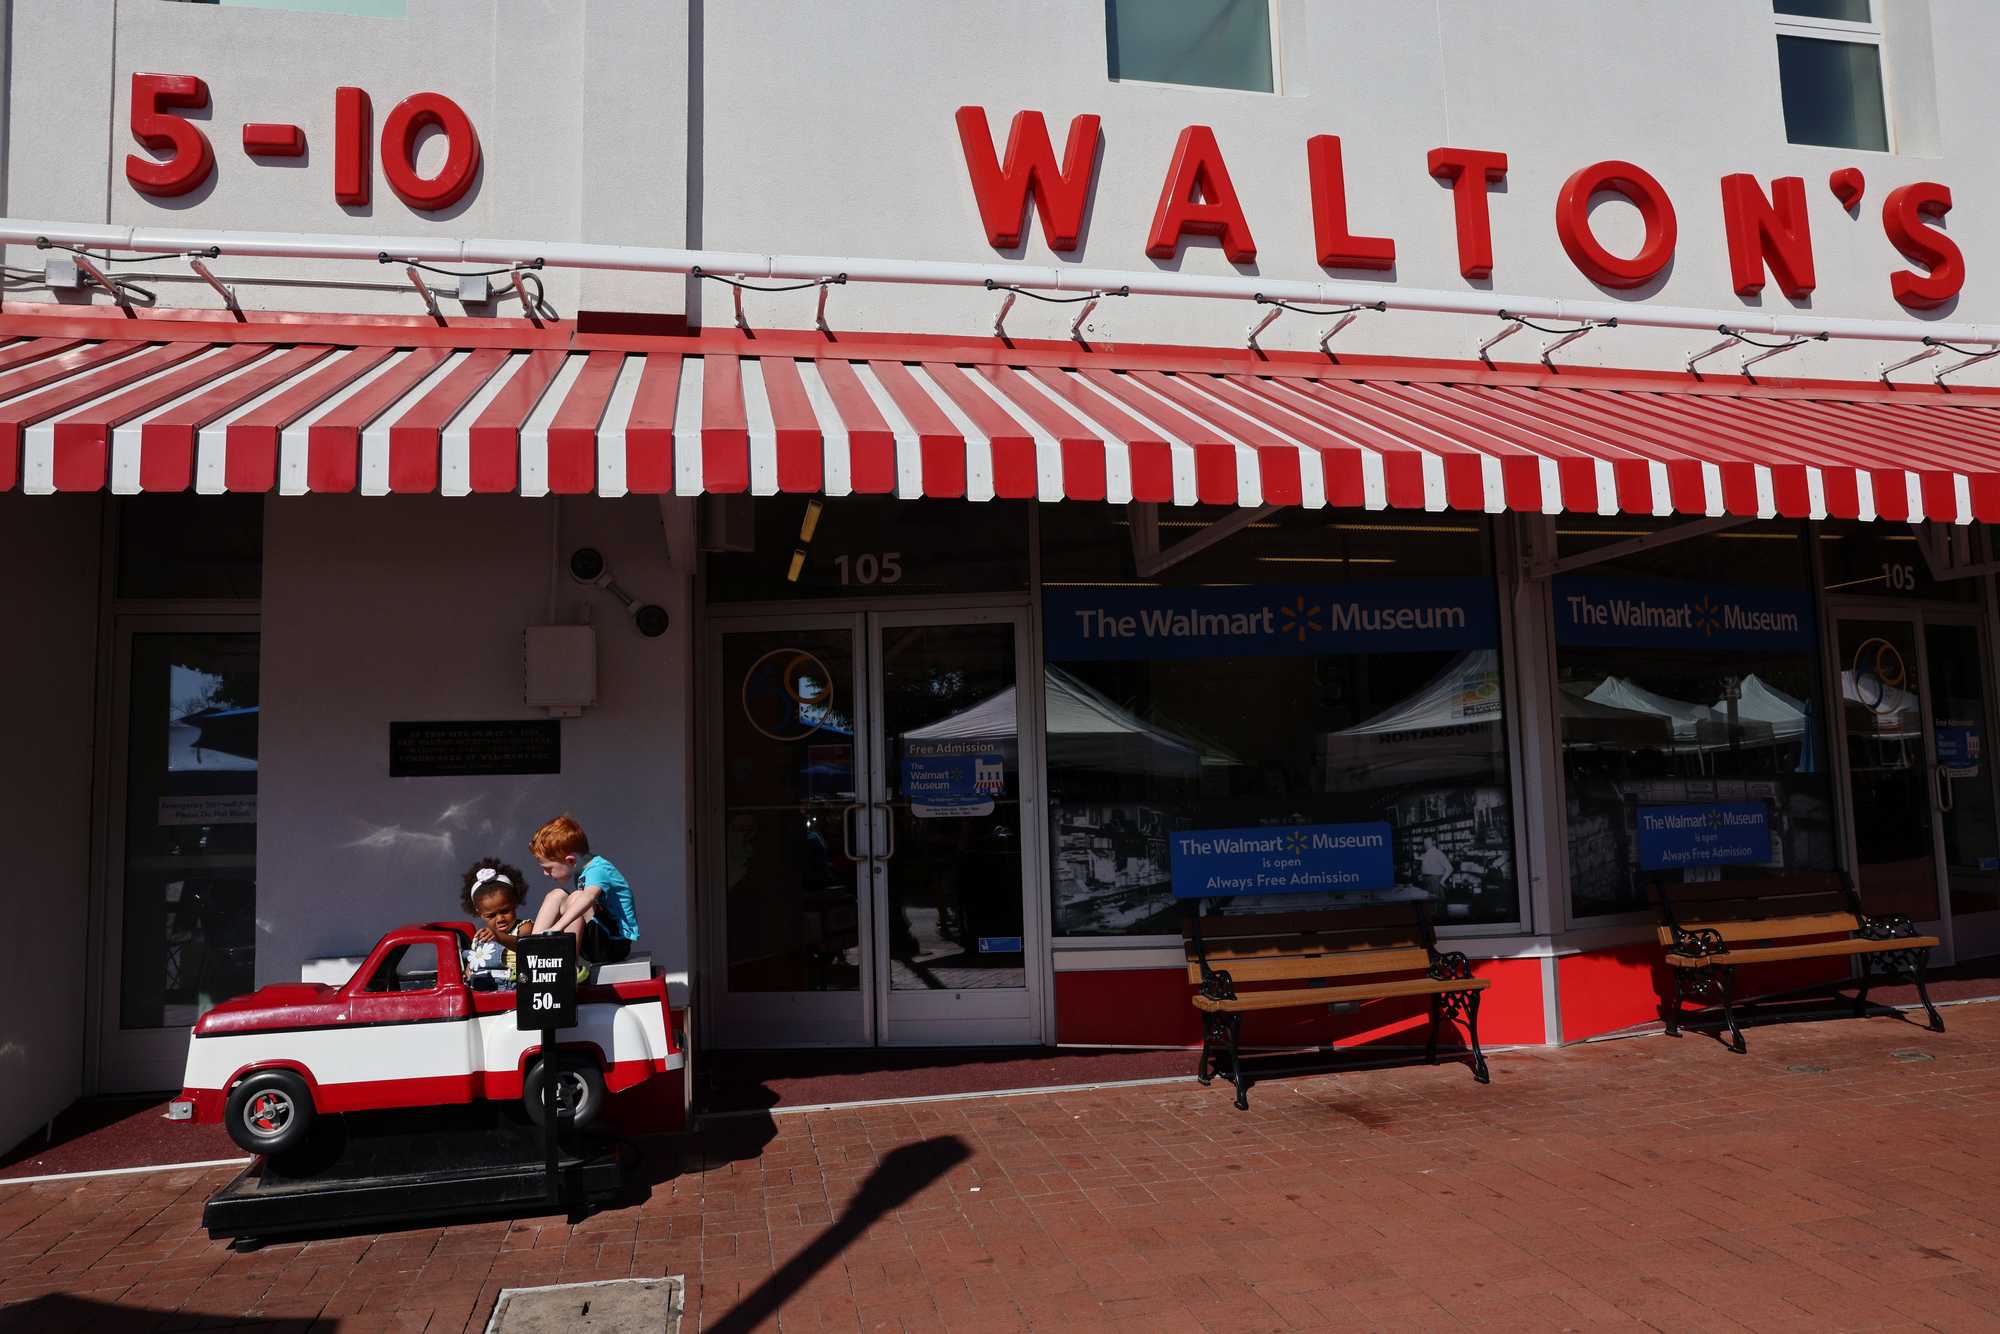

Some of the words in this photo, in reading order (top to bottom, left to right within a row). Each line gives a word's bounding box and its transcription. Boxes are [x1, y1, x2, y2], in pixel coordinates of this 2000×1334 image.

[126, 72, 480, 211] 5-10
[955, 105, 1967, 310] WALTON'S
[833, 552, 903, 585] 105
[1880, 562, 1915, 591] 105
[1074, 608, 1137, 640] The
[1139, 606, 1275, 638] Walmart
[1331, 602, 1465, 632] Museum
[1567, 595, 1609, 625] The
[1609, 599, 1693, 629] Walmart
[1724, 604, 1799, 632] Museum
[910, 744, 935, 754] Free
[936, 741, 994, 753] Admission
[911, 771, 949, 780] Walmart
[911, 782, 949, 792] Museum
[1643, 816, 1665, 830] The
[1664, 814, 1706, 828] Walmart
[1723, 812, 1763, 825] Museum
[1179, 840, 1211, 855] The
[1213, 836, 1283, 854] Walmart
[1312, 834, 1382, 849] Museum
[1262, 858, 1271, 867] is
[1273, 858, 1301, 870] open
[1662, 849, 1690, 863] Always
[1692, 848, 1710, 859] Free
[1712, 847, 1752, 857] Admission
[1206, 876, 1253, 891] Always
[1256, 874, 1286, 886] Free
[1290, 870, 1360, 884] Admission
[526, 955, 563, 968] WEIGHT
[532, 970, 557, 982] LIMIT
